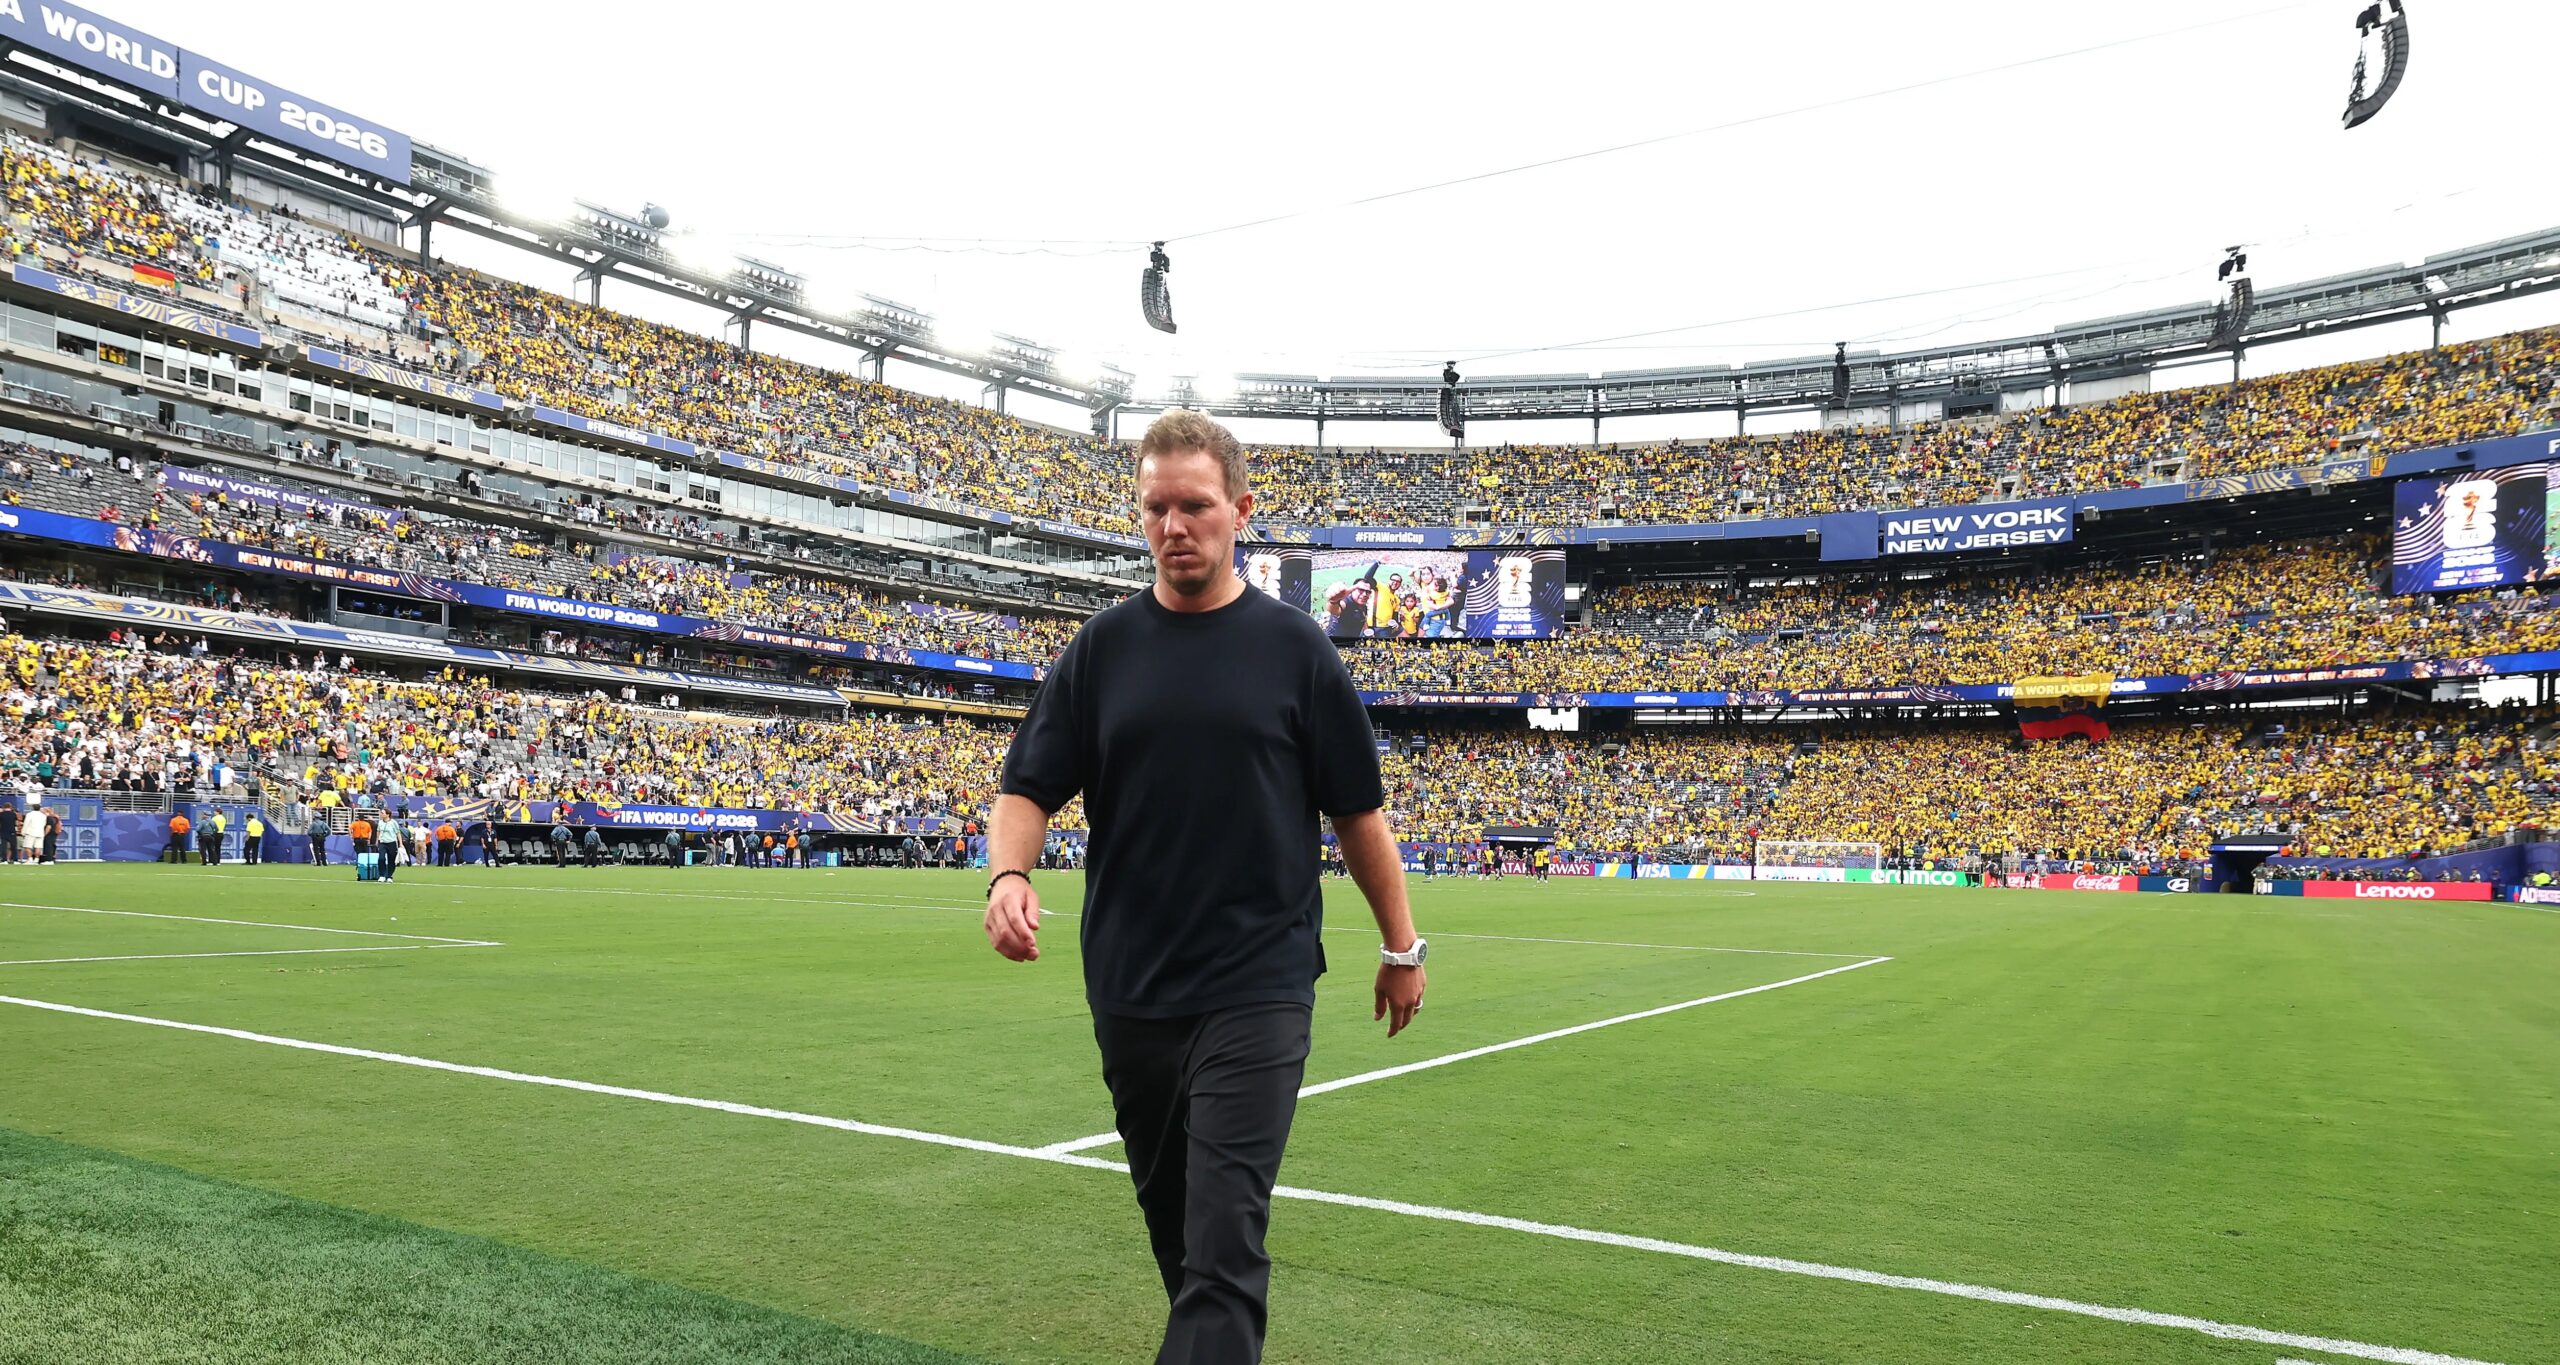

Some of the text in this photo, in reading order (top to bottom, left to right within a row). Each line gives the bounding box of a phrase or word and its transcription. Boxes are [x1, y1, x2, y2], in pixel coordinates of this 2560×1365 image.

[40, 5, 177, 80] WORLD
[198, 70, 266, 112] CUP
[279, 101, 389, 159] 2026
[178, 471, 225, 489] NEW
[227, 481, 280, 500] YORK
[1887, 506, 2068, 537] NEW YORK
[1044, 523, 1065, 533] NEW
[1066, 527, 1090, 537] YORK
[1091, 532, 1111, 541] NEW
[1355, 531, 1424, 544] #FIFAWorldCup
[1887, 527, 2067, 554] NEW JERSEY
[238, 551, 400, 587] NEW YORK NEW JERSEY
[506, 594, 659, 628] FIFA WORLD CUP 2026
[743, 630, 848, 653] NEW YORK NEW JERSEY
[2244, 667, 2386, 684] NEW YORK NEW JERSEY
[1799, 691, 1911, 702] NEW YORK NEW JERSEY
[1997, 685, 2025, 697] FIFA
[2025, 684, 2070, 696] WORLD
[2071, 682, 2098, 694] CUP
[1419, 695, 1518, 704] NEW YORK NEW JERSEY
[650, 711, 688, 719] JERSEY
[613, 811, 758, 828] FIFA WORLD CUP 2026
[1637, 864, 1671, 878] VISA
[1871, 869, 1957, 886] aramco
[2355, 882, 2435, 898] Lenovo
